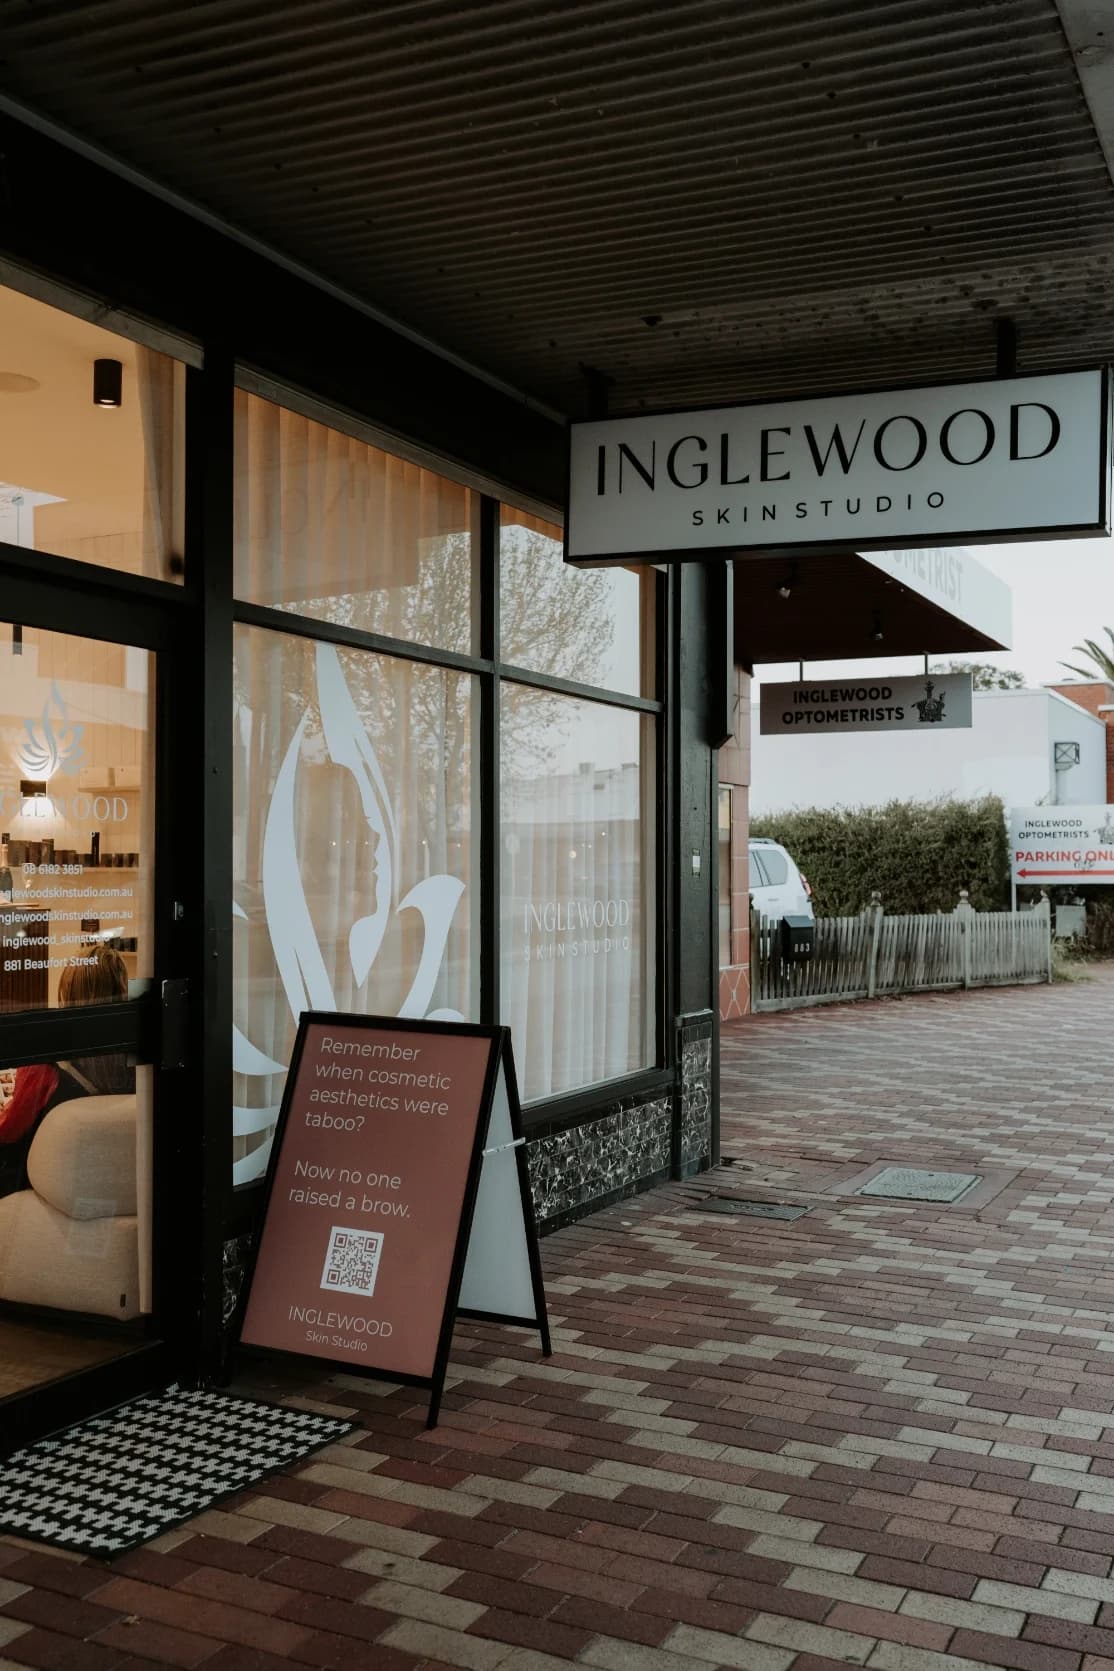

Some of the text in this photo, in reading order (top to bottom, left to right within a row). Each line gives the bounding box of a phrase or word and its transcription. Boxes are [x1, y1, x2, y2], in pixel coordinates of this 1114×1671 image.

[597, 402, 1061, 496] INGLEWOOD
[793, 686, 893, 704] INGLEWOOD
[782, 707, 905, 725] OPTOMETRISTS
[1025, 819, 1083, 828] INGLEWOOD
[1018, 831, 1089, 839] OPTOMETRISTS
[1015, 851, 1082, 862] PARKING
[23, 864, 83, 874] 08 6182 3851
[523, 899, 630, 936] INGLEWOOD
[4, 954, 98, 971] 881 Beaufort Street
[320, 1037, 421, 1061] Remember
[315, 1062, 451, 1090] when cosmetic
[309, 1088, 449, 1116] aesthetics were
[305, 1111, 365, 1132] taboo?
[294, 1160, 402, 1190] Now no one
[289, 1187, 411, 1218] raised a brow.
[288, 1306, 393, 1337] INGLEWOOD
[305, 1330, 368, 1351] Skin Studio
